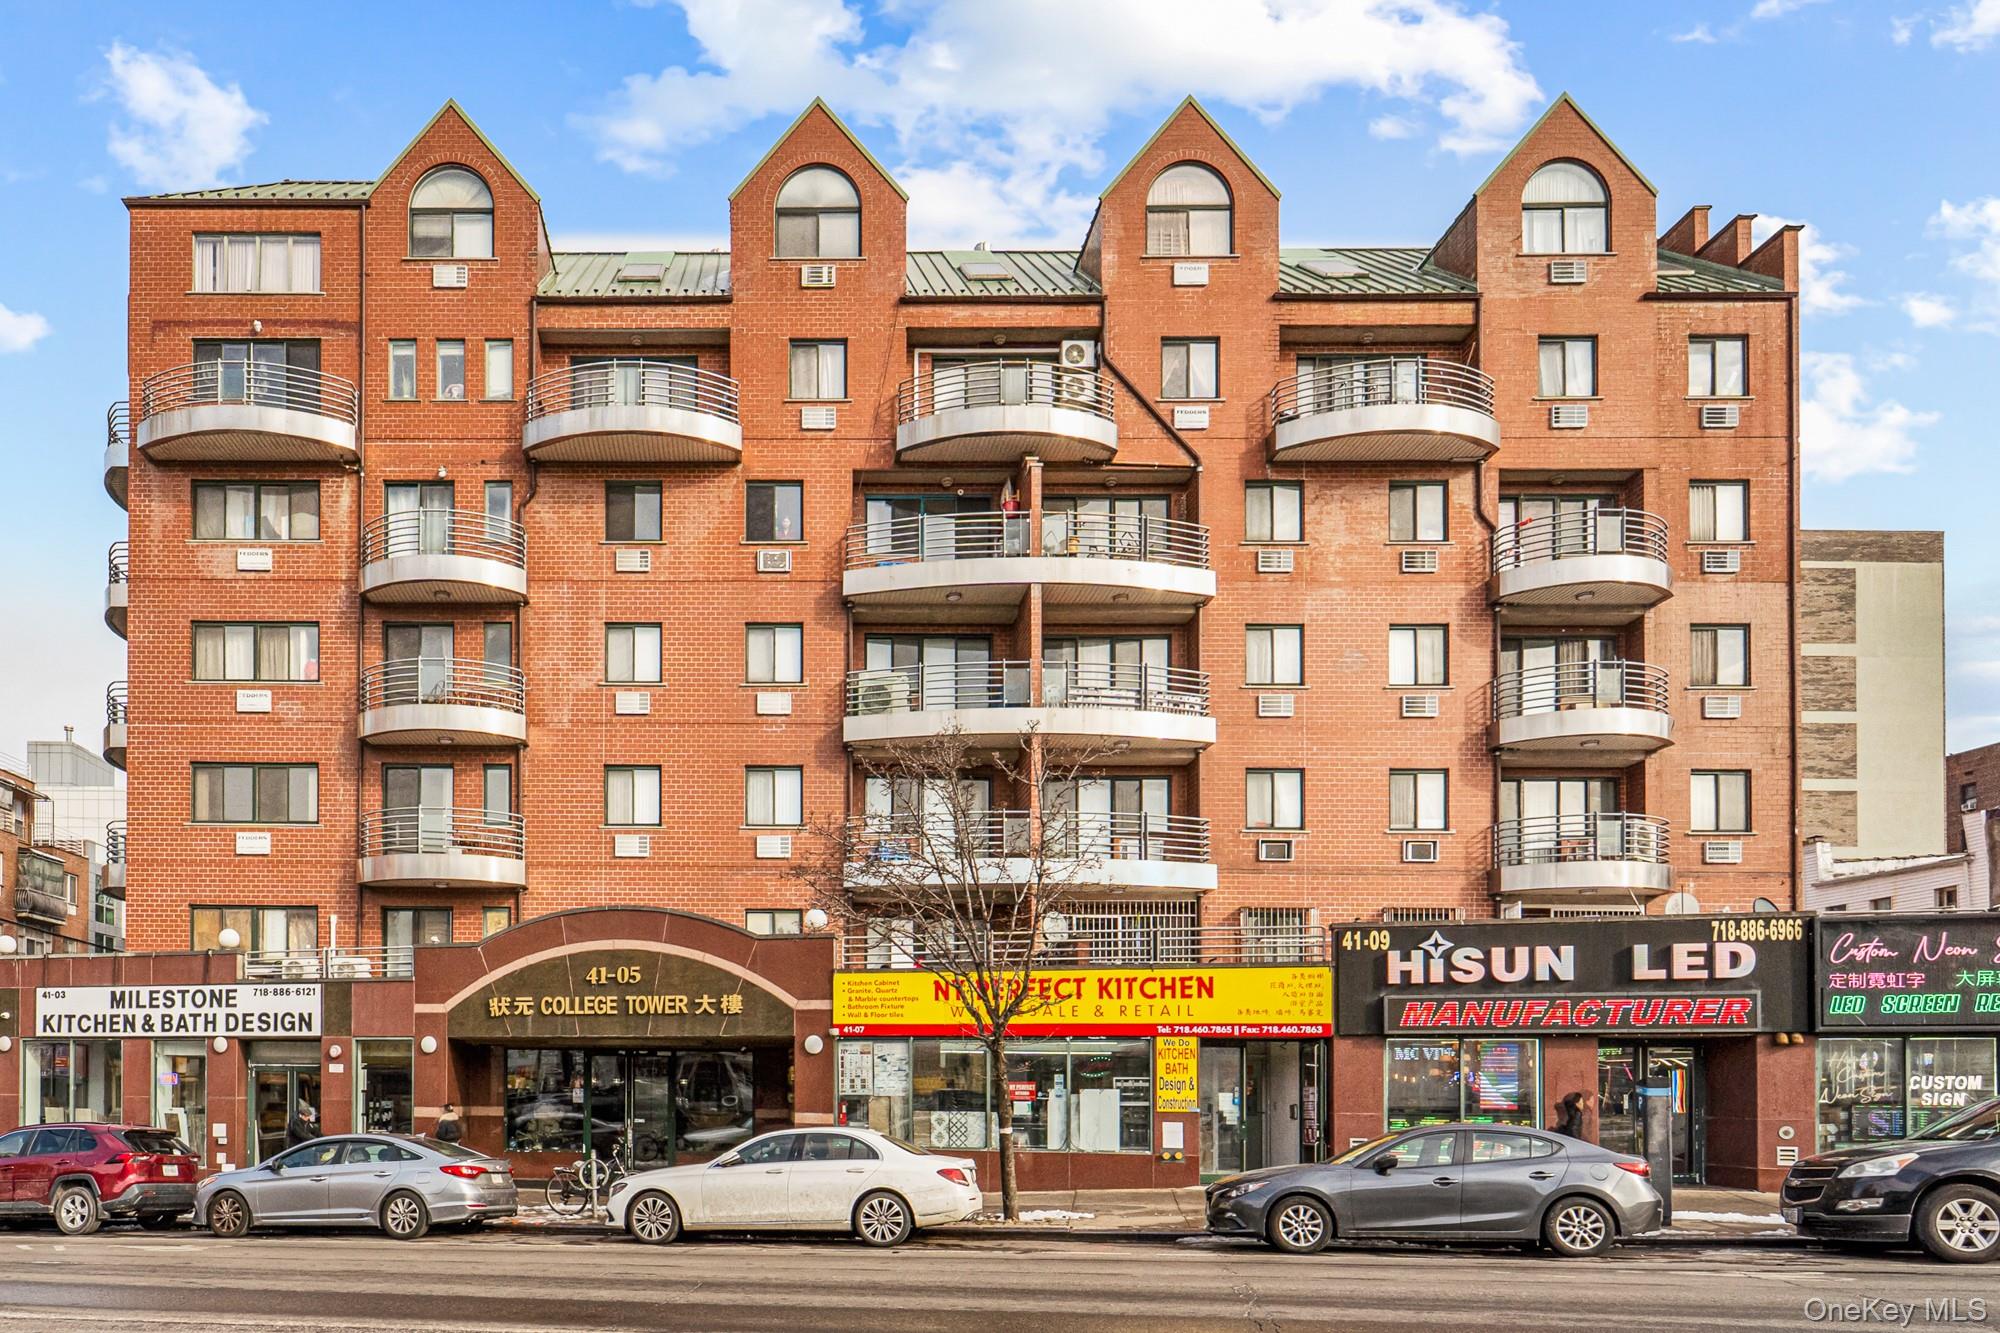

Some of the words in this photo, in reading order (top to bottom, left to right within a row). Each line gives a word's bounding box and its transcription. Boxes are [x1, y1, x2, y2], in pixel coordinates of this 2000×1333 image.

[1712, 918, 1803, 942] 718-886-6966
[1342, 930, 1390, 951] 41-09
[1830, 932, 1898, 964] Custom
[1913, 931, 1978, 964] Neon
[1631, 942, 1757, 980] LED
[585, 966, 642, 985] 41-05
[1829, 972, 1925, 989] 定制霓虹字
[42, 990, 66, 1000] 41-03
[253, 987, 316, 997] 718-886-6121
[975, 976, 1086, 1001] PERFECT
[1097, 976, 1214, 1000] KITCHEN
[110, 988, 238, 1009] MILESTONE
[541, 995, 618, 1015] COLLEGE
[625, 995, 688, 1015] TOWER
[694, 993, 744, 1015] 大樓
[1829, 995, 1866, 1014] LED
[1881, 994, 1961, 1014] SCREEN
[950, 1005, 1078, 1018] WSALE
[1094, 1005, 1105, 1017] &
[1119, 1005, 1194, 1017] RETAIL
[1399, 997, 1753, 1028] MANUFACTURER
[42, 1013, 137, 1034] KITCHEN
[141, 1014, 155, 1033] &
[160, 1012, 217, 1033] BATH
[225, 1011, 313, 1033] DESIGN
[1157, 1025, 1171, 1034] Tel:
[1173, 1025, 1232, 1034] 718.460.7865
[1241, 1026, 1260, 1034] Fax:
[1261, 1025, 1322, 1034] 718.460.7863
[1163, 1038, 1176, 1047] We
[1178, 1038, 1190, 1047] Do
[1158, 1048, 1195, 1060] KITCHEN
[1165, 1063, 1188, 1075] BATH
[1159, 1076, 1187, 1094] Design
[1189, 1076, 1194, 1091] &
[1909, 1075, 1982, 1090] CUSTOM
[1158, 1095, 1197, 1110] Construction
[1920, 1092, 1965, 1107] SIGN
